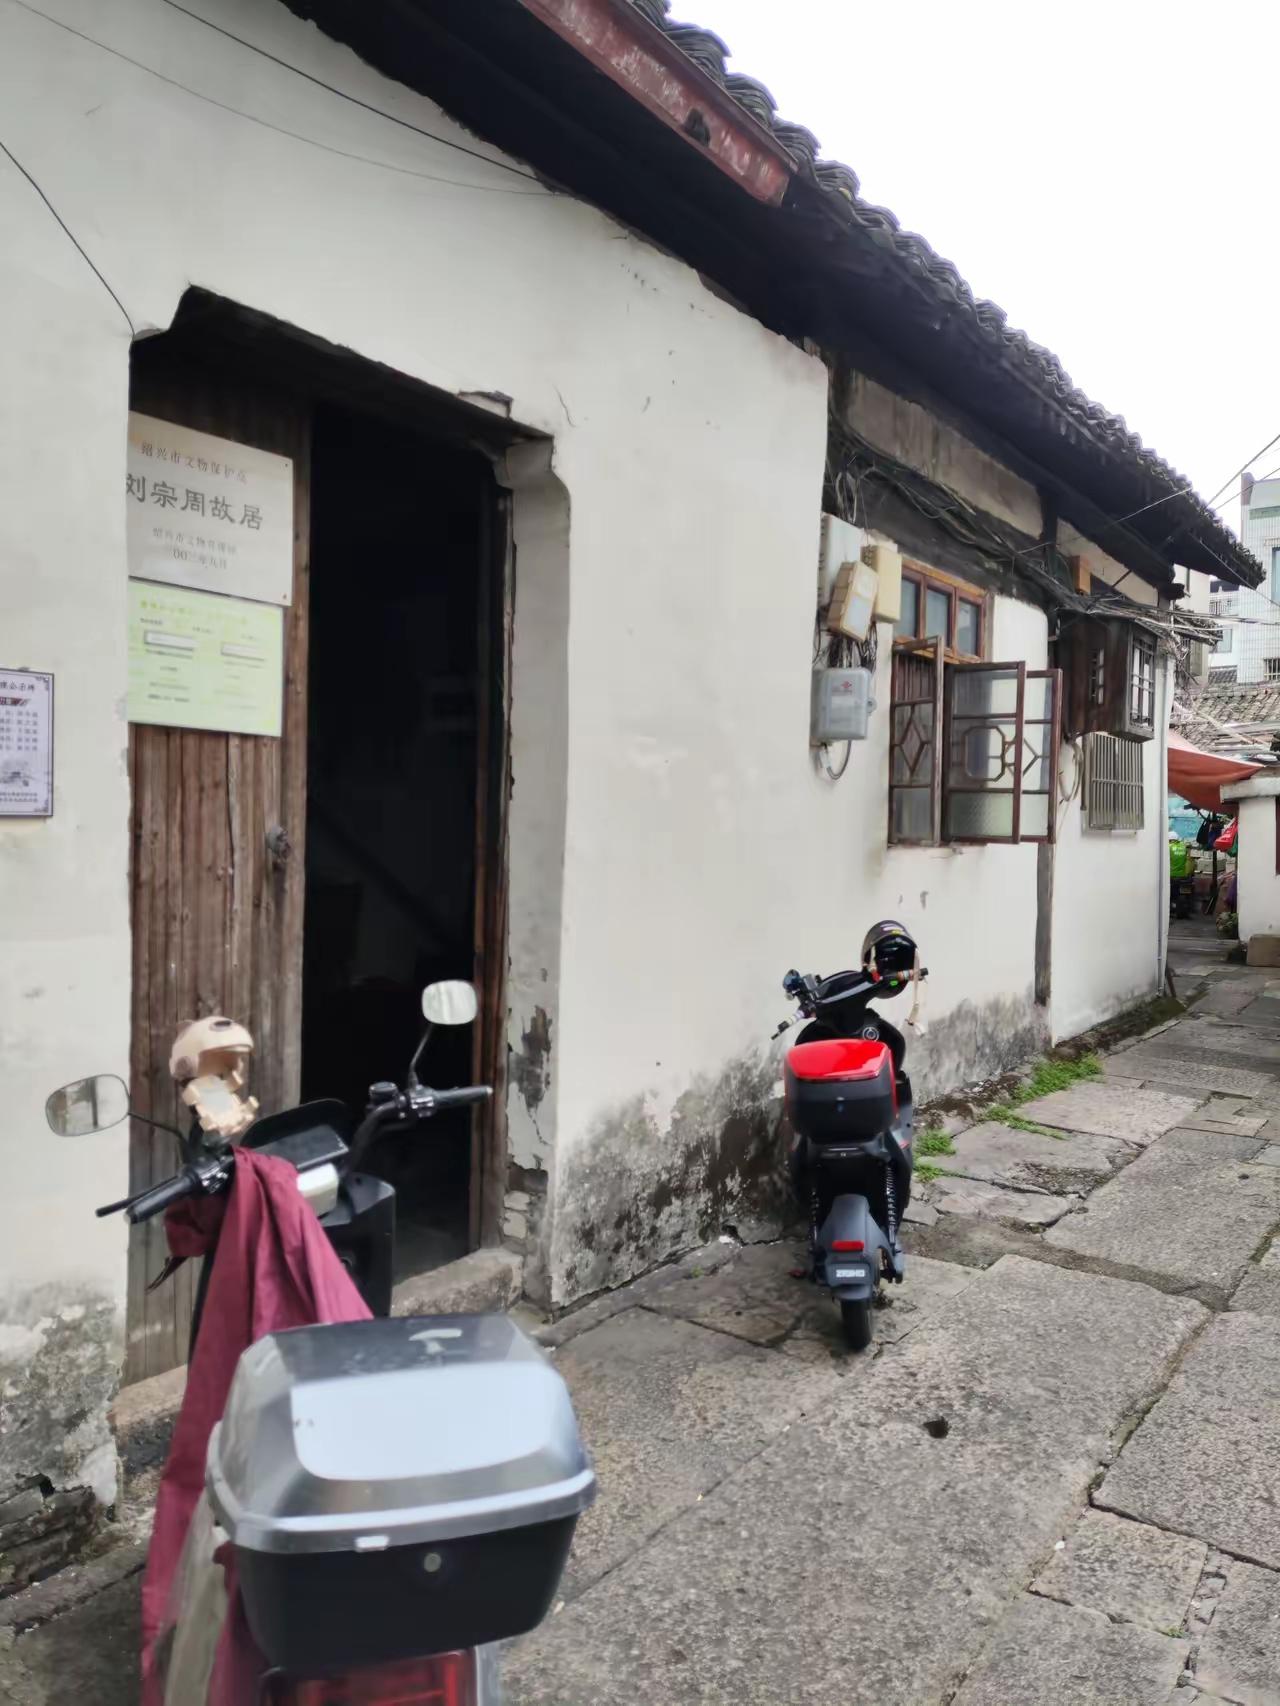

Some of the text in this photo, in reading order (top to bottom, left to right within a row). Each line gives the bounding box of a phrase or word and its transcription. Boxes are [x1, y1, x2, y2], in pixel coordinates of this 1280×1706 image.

[126, 473, 264, 531] 刘宗周故居
